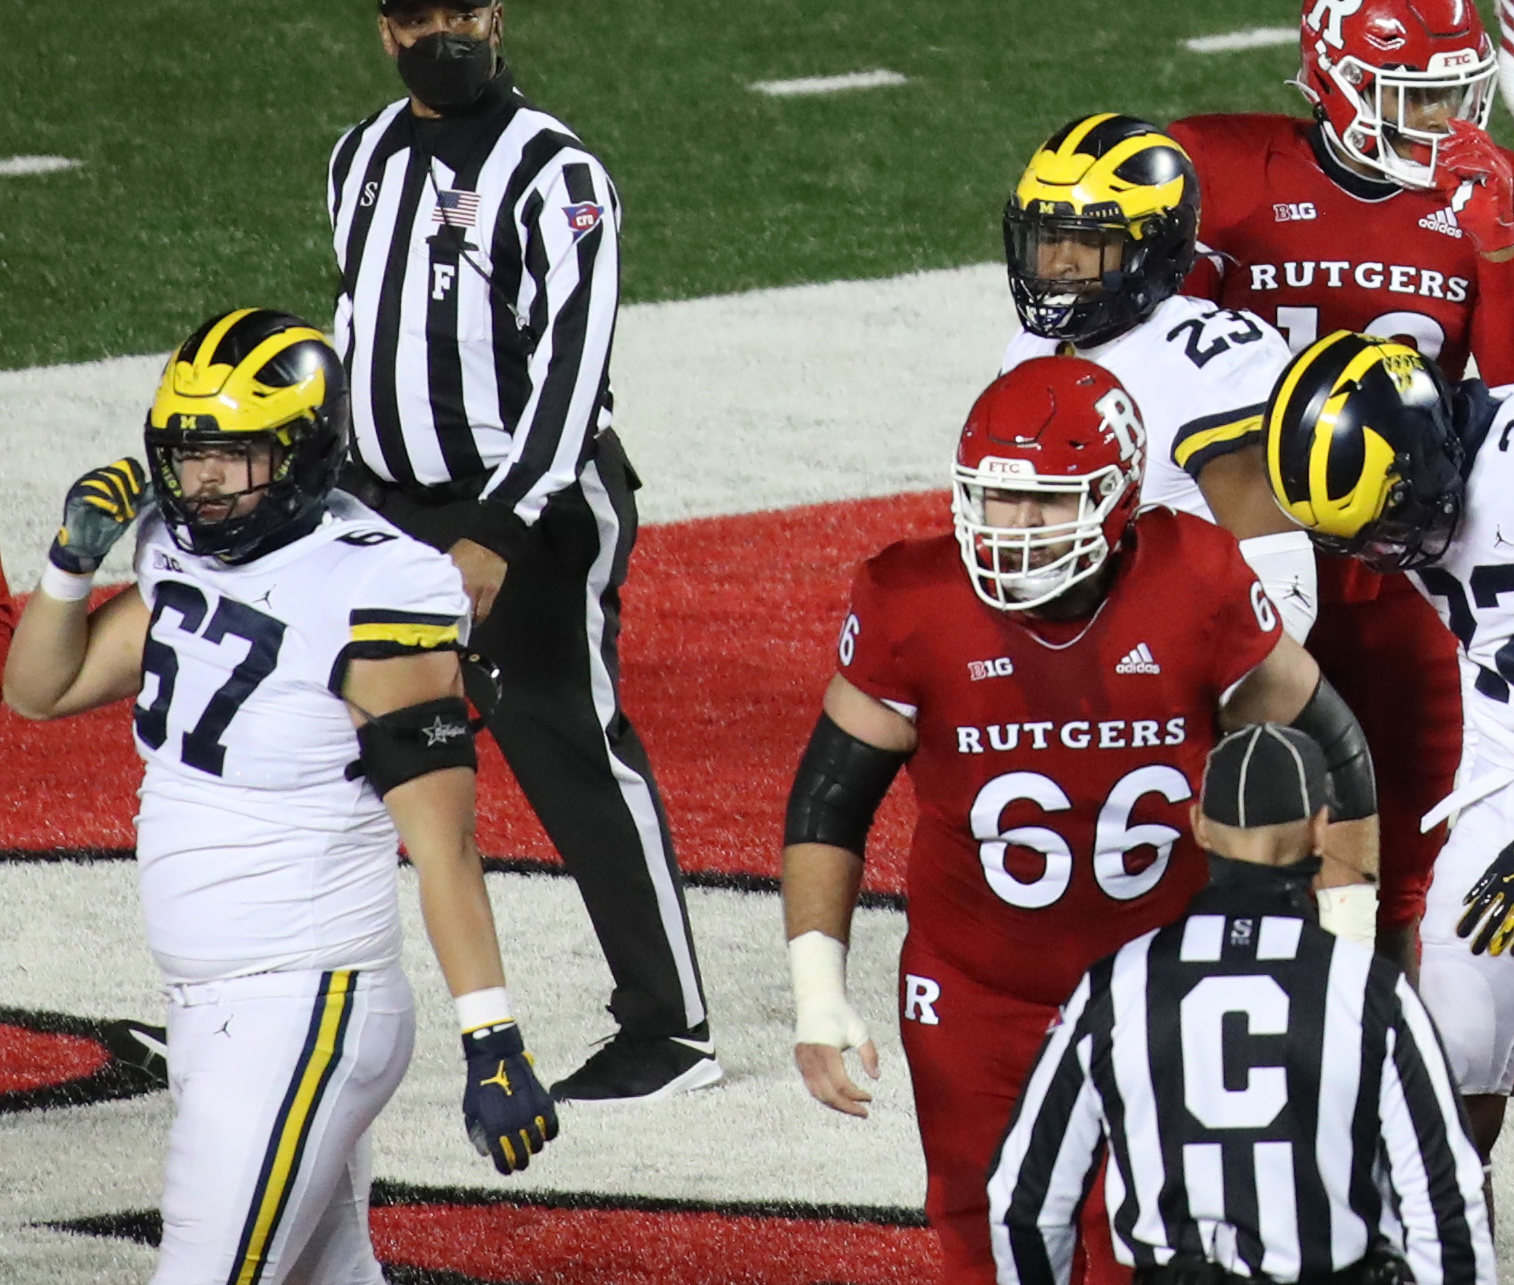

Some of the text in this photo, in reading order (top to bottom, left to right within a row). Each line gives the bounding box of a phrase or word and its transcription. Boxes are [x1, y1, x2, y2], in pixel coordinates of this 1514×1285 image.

[1443, 53, 1470, 67] FTC
[1039, 202, 1055, 214] M
[1273, 202, 1318, 221] B1G
[1418, 217, 1463, 239] adidas
[432, 263, 455, 301] F
[1251, 260, 1469, 303] RUTGERS
[1166, 307, 1263, 370] 23
[180, 415, 198, 430] M
[1094, 387, 1146, 462] R
[987, 461, 1021, 475] FTC
[132, 579, 288, 778] 67
[967, 657, 1014, 680] B1G
[1115, 663, 1161, 675] adidas
[956, 718, 1186, 754] RUTGERS
[969, 764, 1193, 910] 66
[904, 973, 940, 1025] R
[1180, 975, 1290, 1129] C
